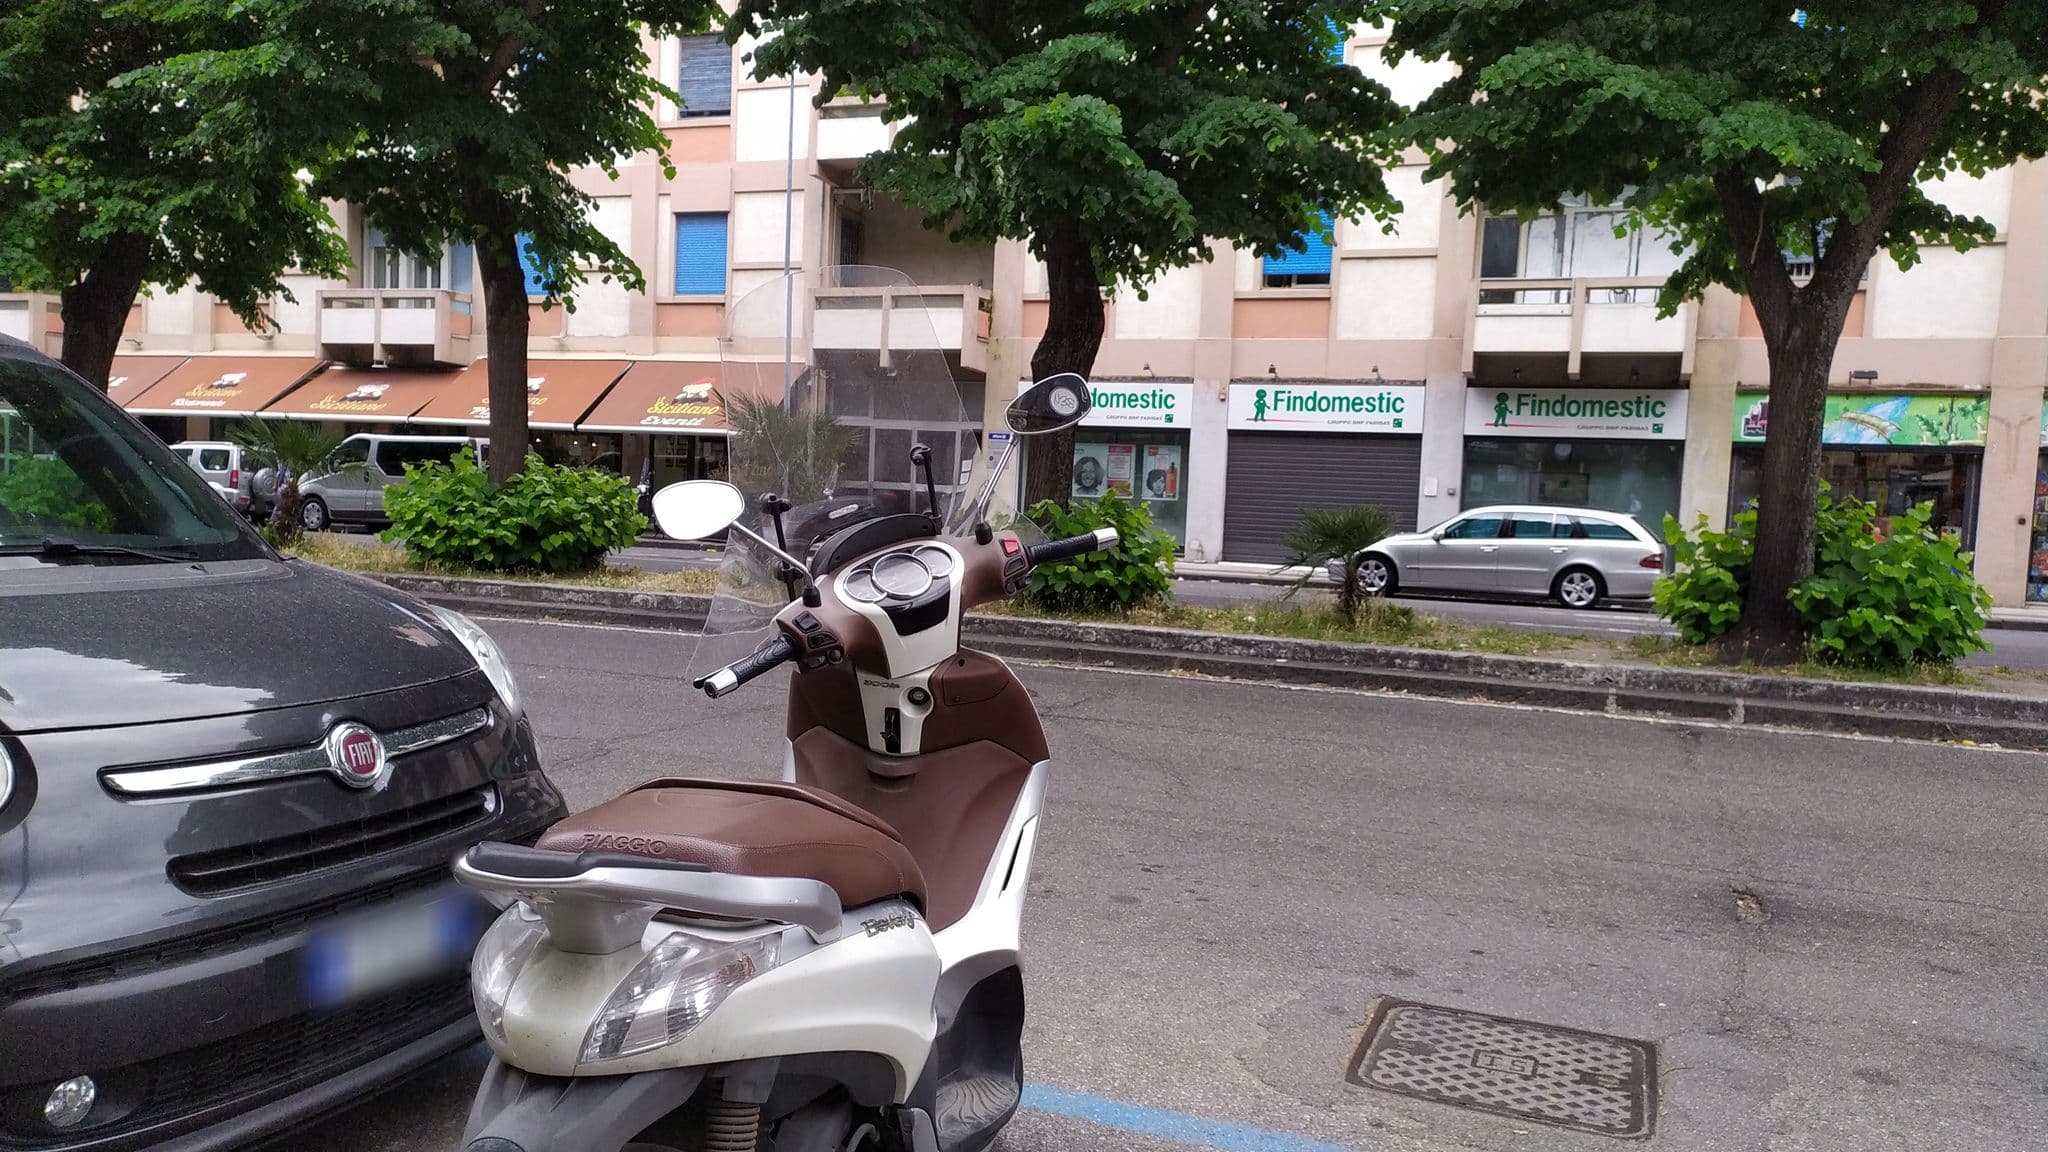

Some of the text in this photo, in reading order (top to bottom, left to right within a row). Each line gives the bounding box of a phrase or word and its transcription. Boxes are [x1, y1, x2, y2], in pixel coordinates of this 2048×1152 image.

[646, 402, 720, 416] Siciliano
[1272, 389, 1406, 414] Findomestic
[1514, 392, 1667, 418] Findomestic
[640, 415, 705, 426] Eventi
[347, 741, 374, 767] FIAT
[580, 834, 669, 855] PIAGGIO
